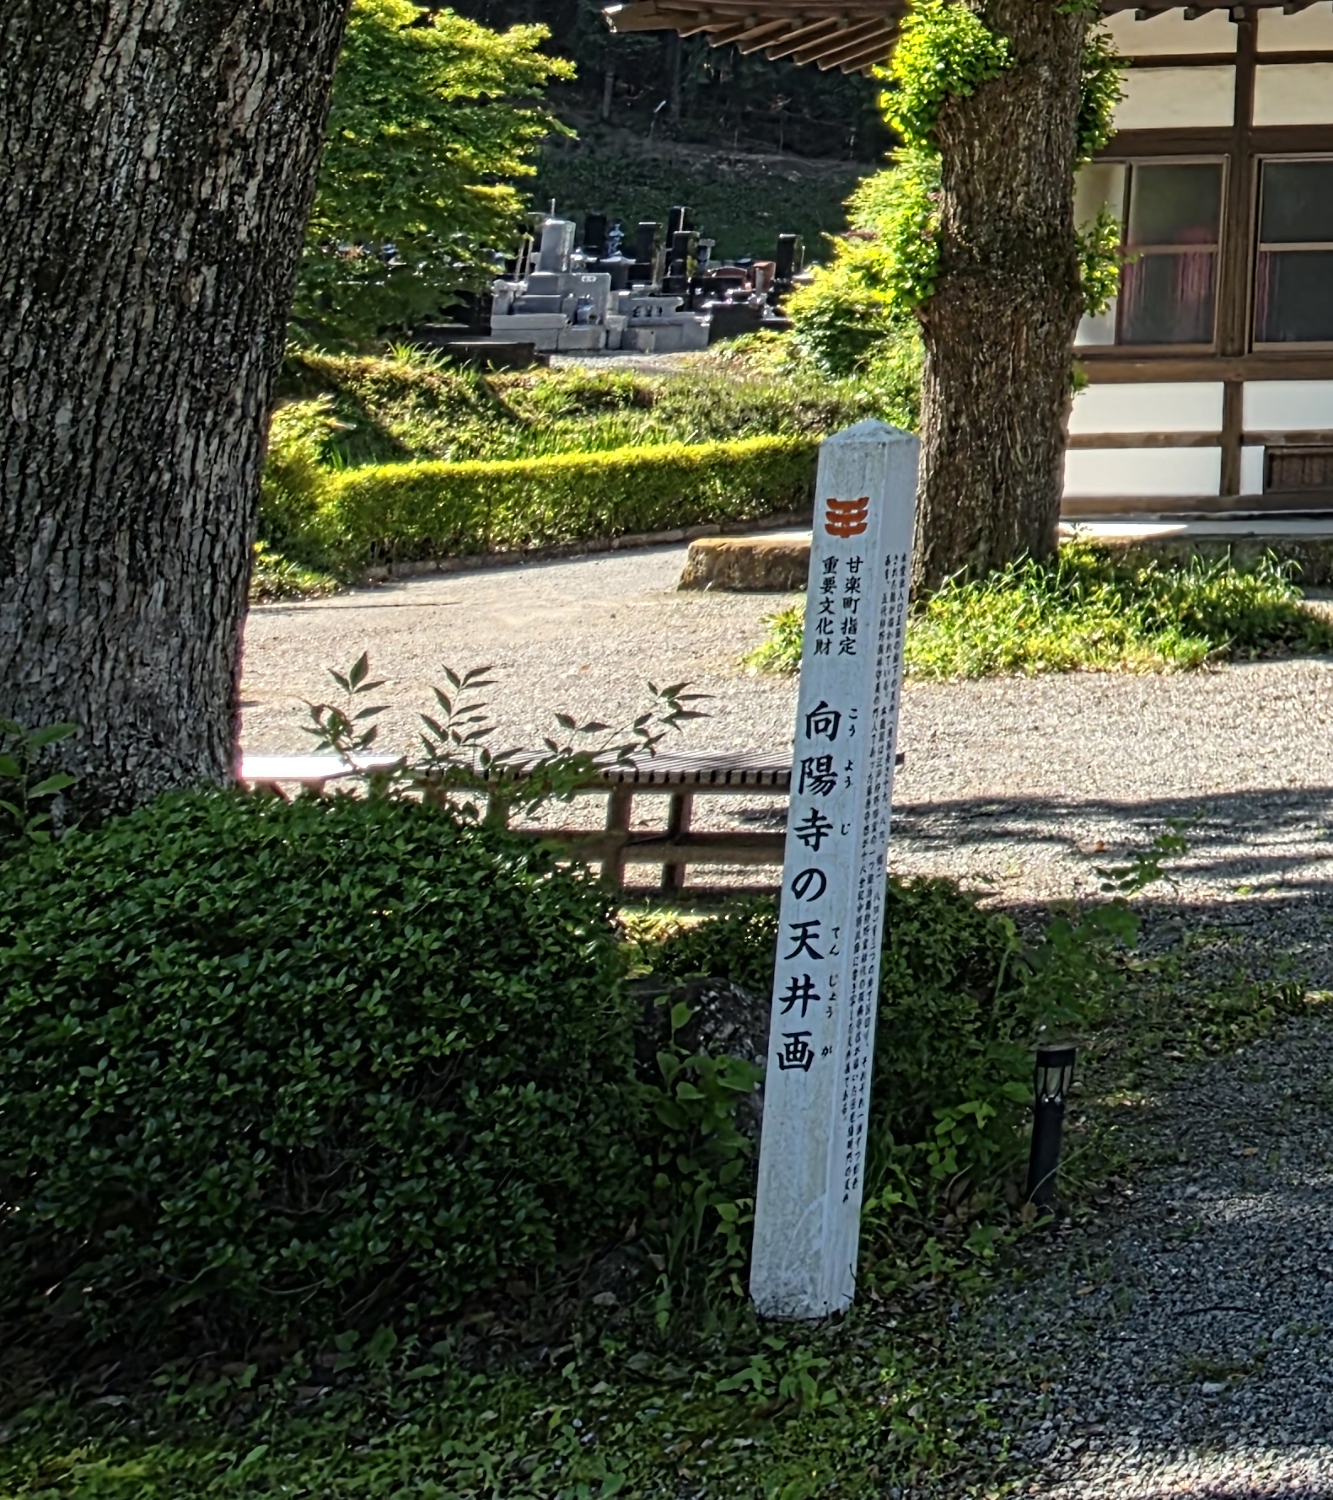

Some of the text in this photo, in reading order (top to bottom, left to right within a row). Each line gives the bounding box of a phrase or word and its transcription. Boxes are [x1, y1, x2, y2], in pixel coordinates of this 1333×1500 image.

[813, 555, 838, 656] 重要文化財
[837, 556, 864, 656] 甘楽町指定
[777, 700, 841, 1074] 向陽寺の天井画
[821, 708, 858, 1057] こう よう じ てん じょう が
